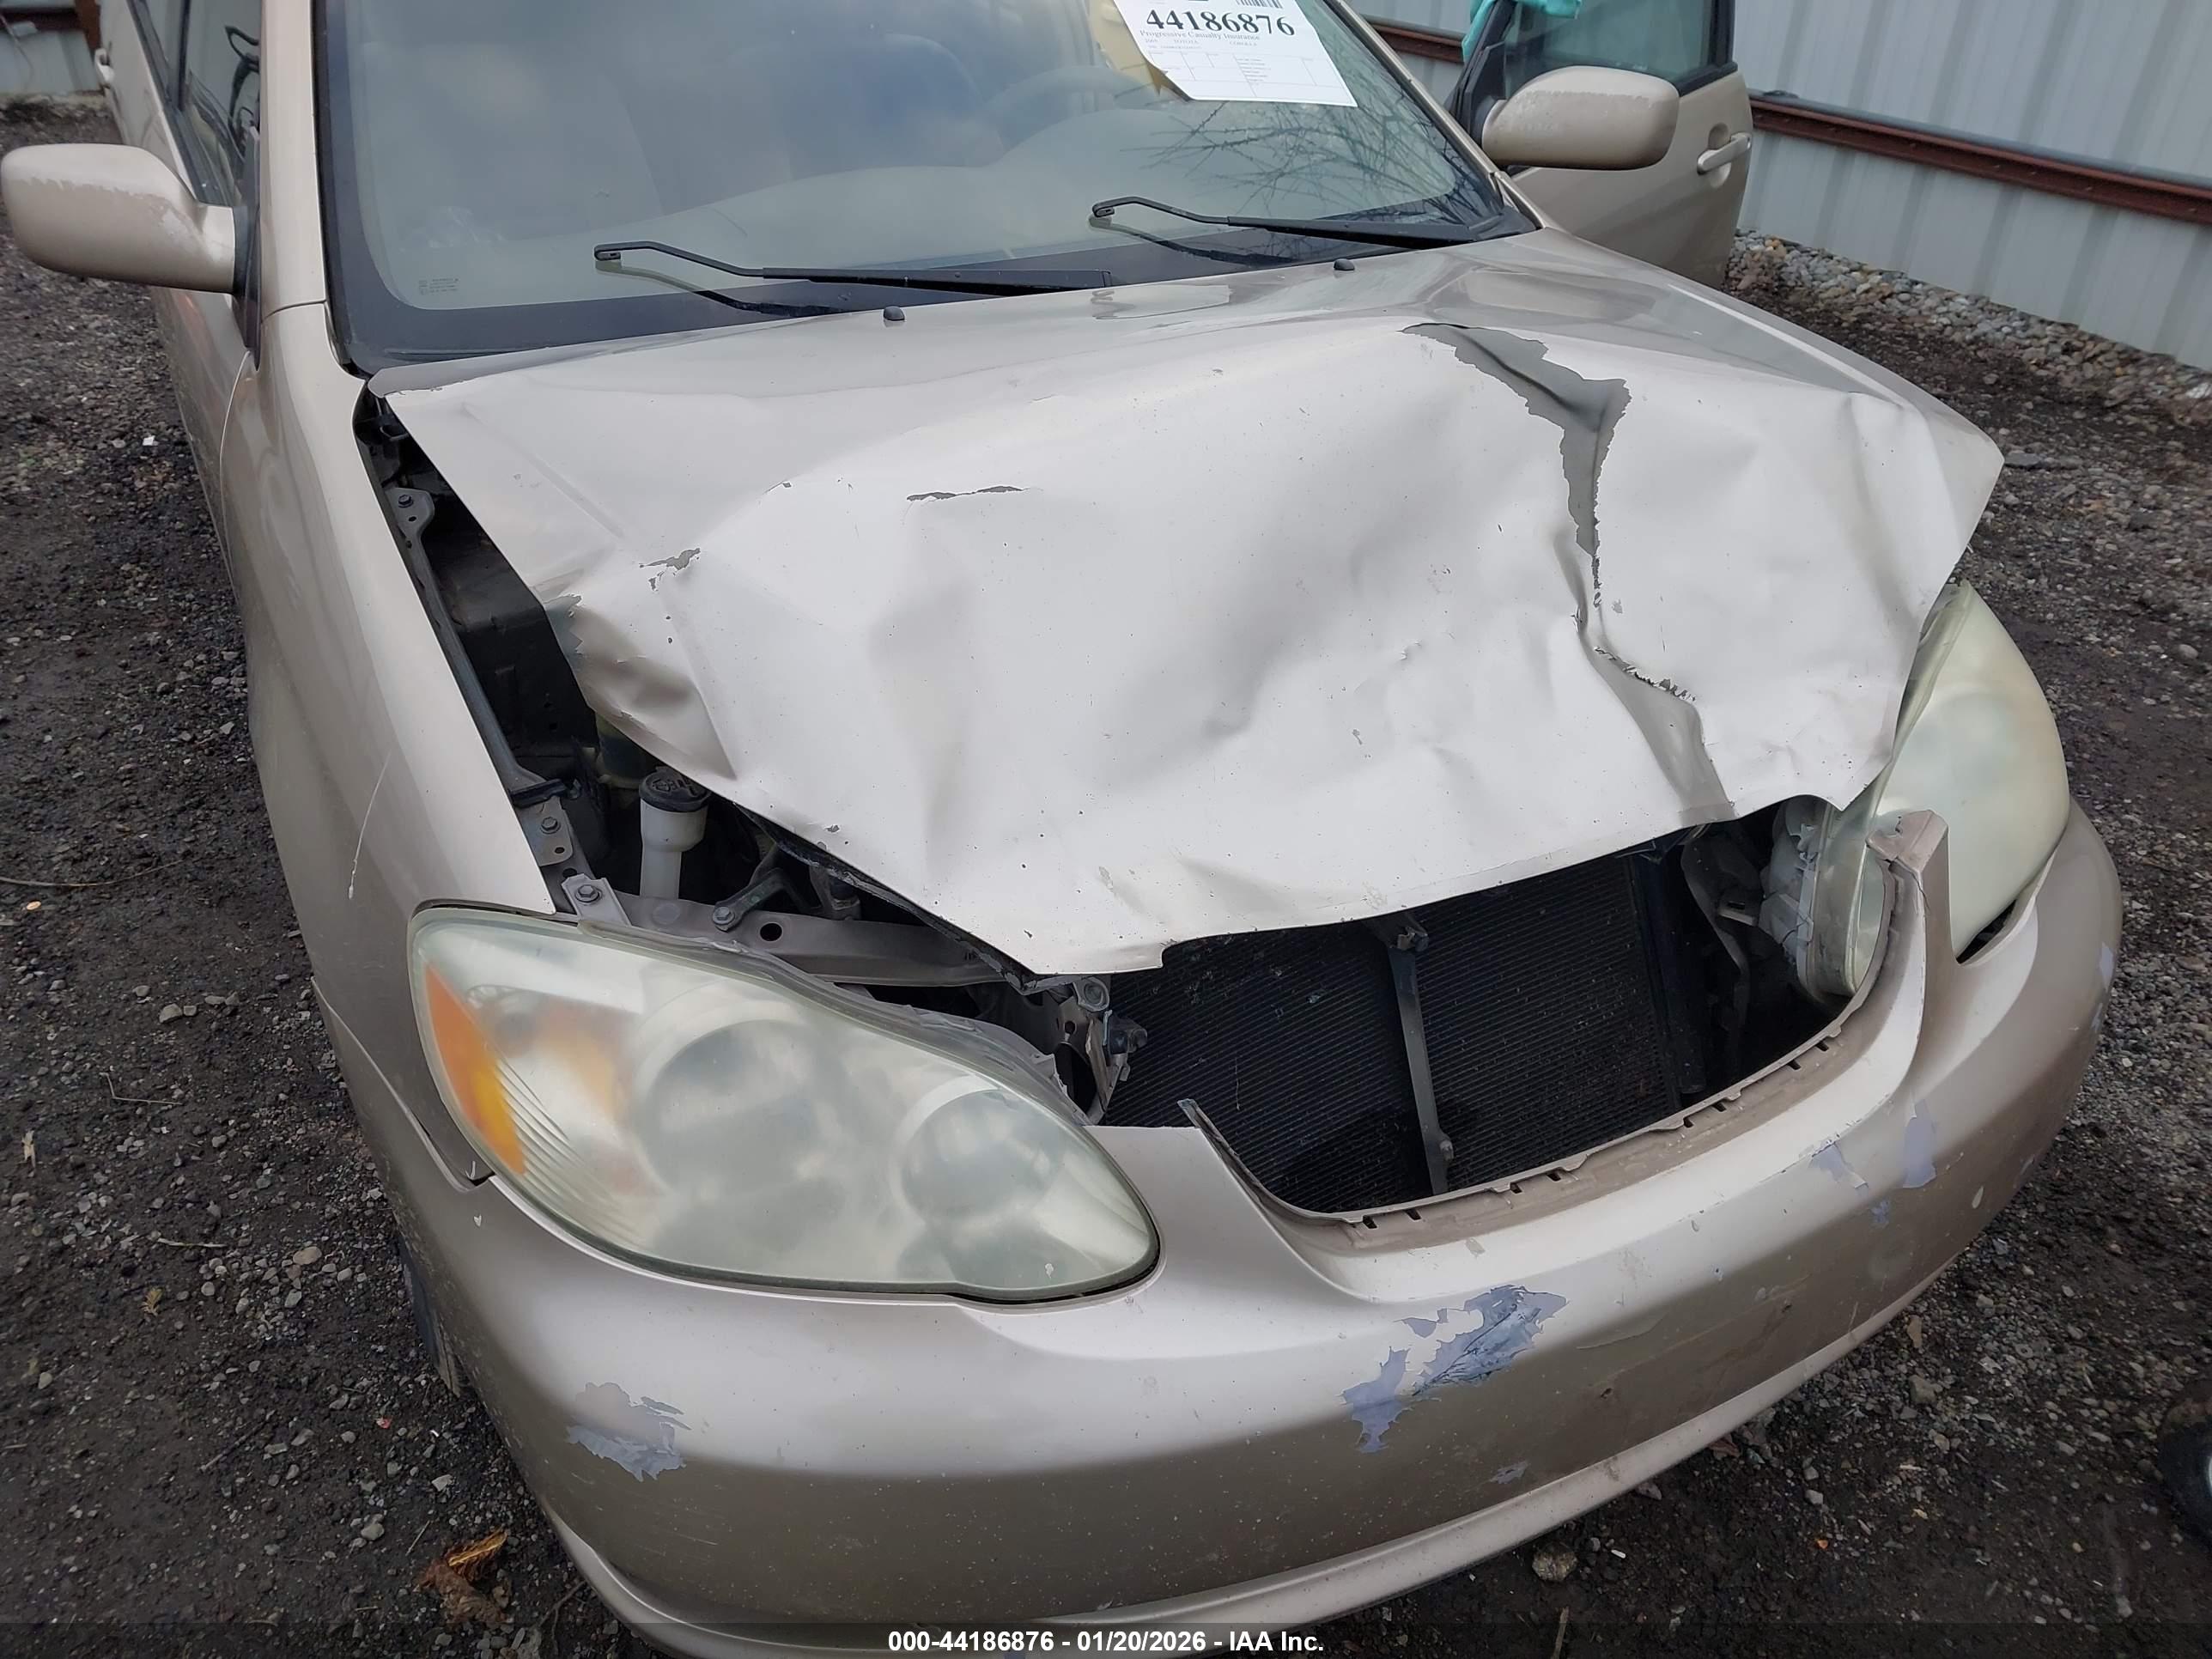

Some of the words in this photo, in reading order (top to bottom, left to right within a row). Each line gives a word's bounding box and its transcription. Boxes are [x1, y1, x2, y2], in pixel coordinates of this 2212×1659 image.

[1146, 9, 1295, 36] 44186876
[1139, 29, 1187, 39] Progressive
[1188, 31, 1221, 40] Casualty
